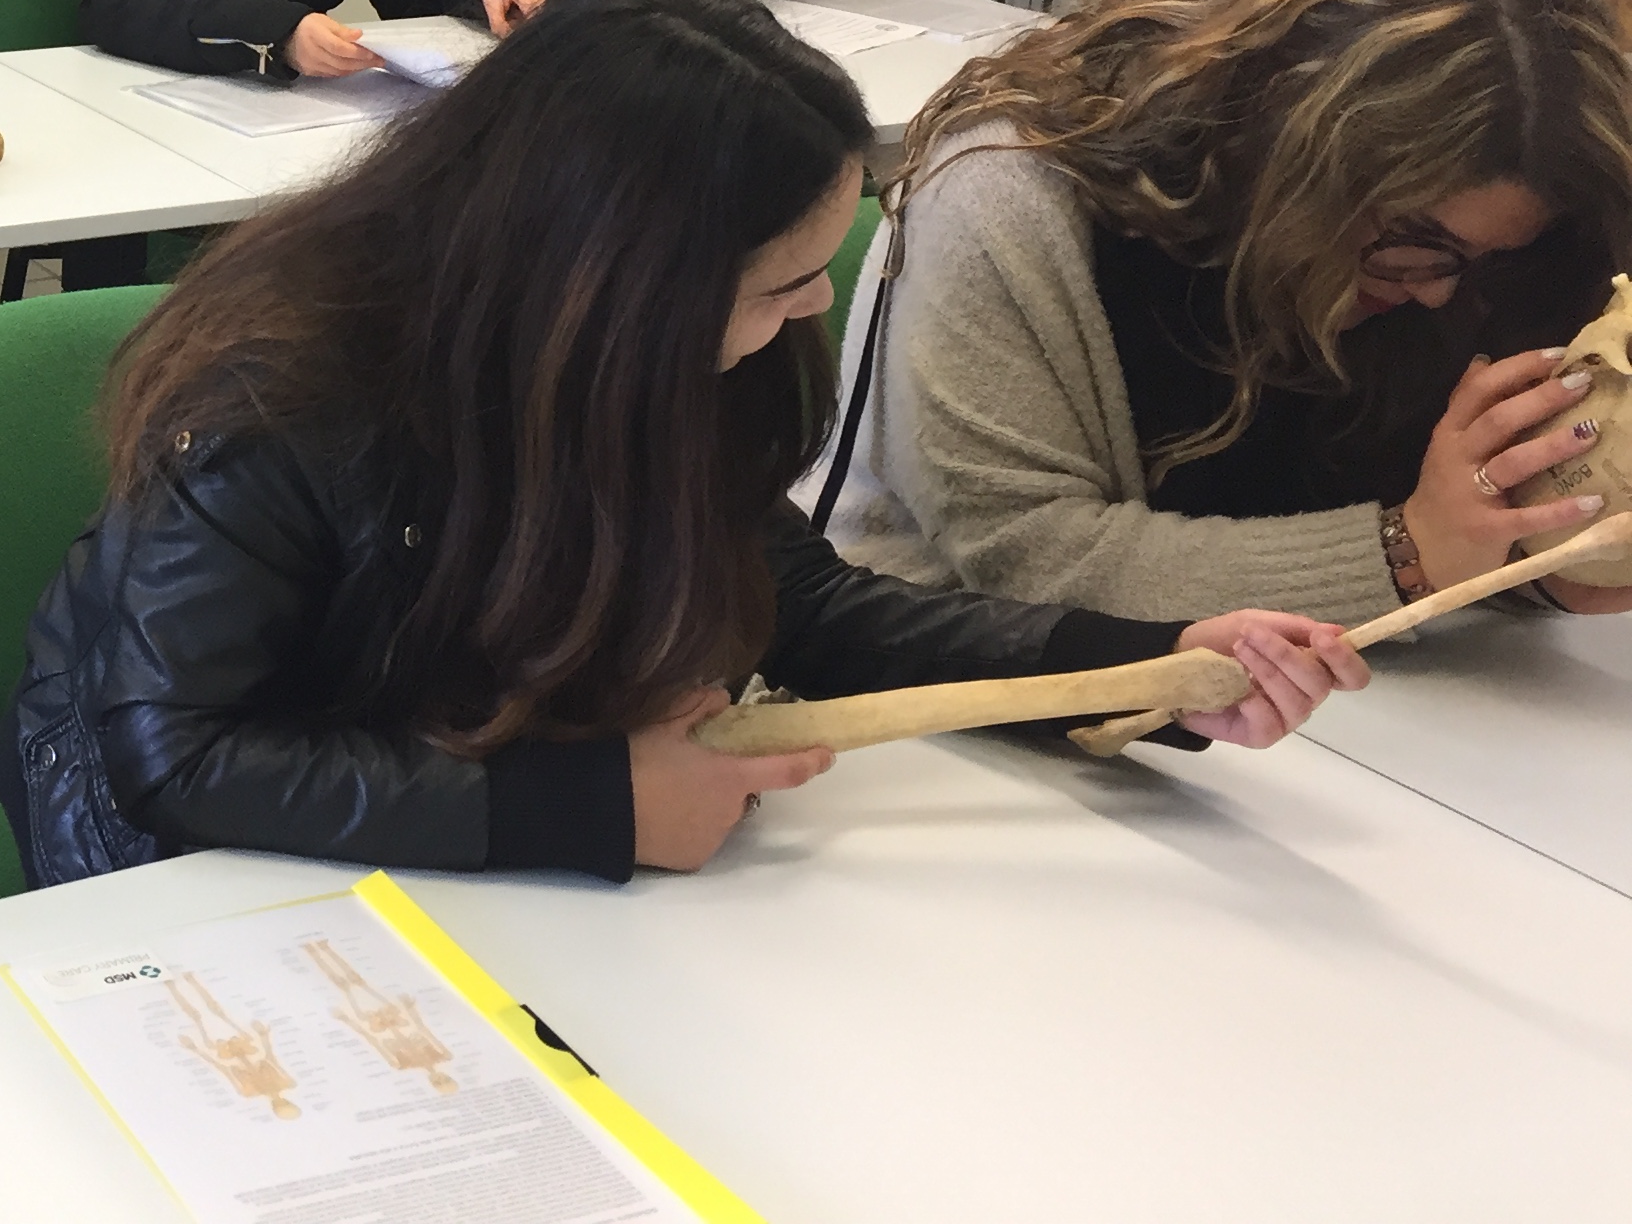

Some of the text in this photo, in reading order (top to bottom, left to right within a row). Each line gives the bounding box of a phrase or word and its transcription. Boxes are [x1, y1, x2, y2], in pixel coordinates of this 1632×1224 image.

[57, 953, 150, 977] PRIMARY CARE
[104, 971, 137, 984] MSD
